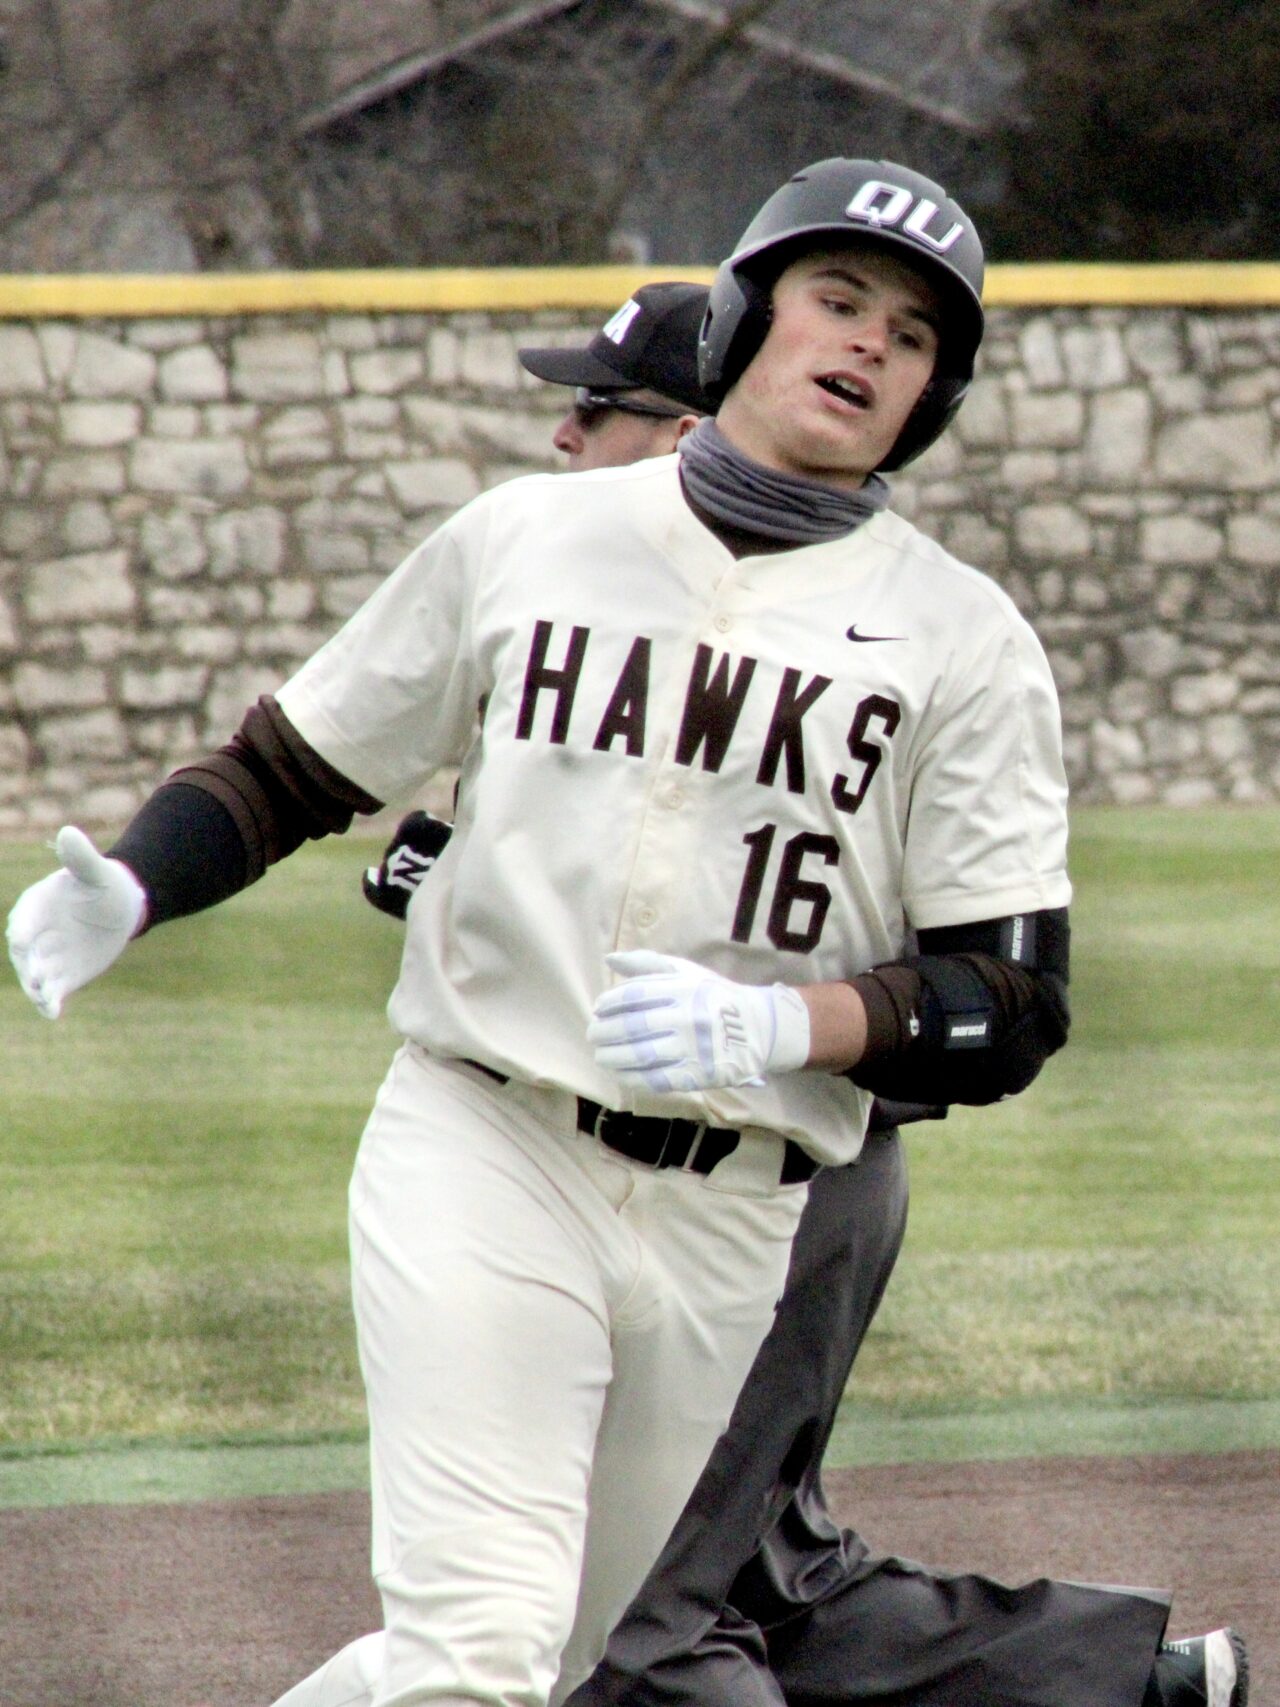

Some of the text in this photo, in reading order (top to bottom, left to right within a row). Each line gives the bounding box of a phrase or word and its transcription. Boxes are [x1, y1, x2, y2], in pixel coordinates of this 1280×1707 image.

[845, 180, 963, 253] QU
[515, 620, 900, 814] HAWKS
[730, 823, 839, 954] 16
[1011, 916, 1023, 960] marucci
[951, 1021, 987, 1037] marucci
